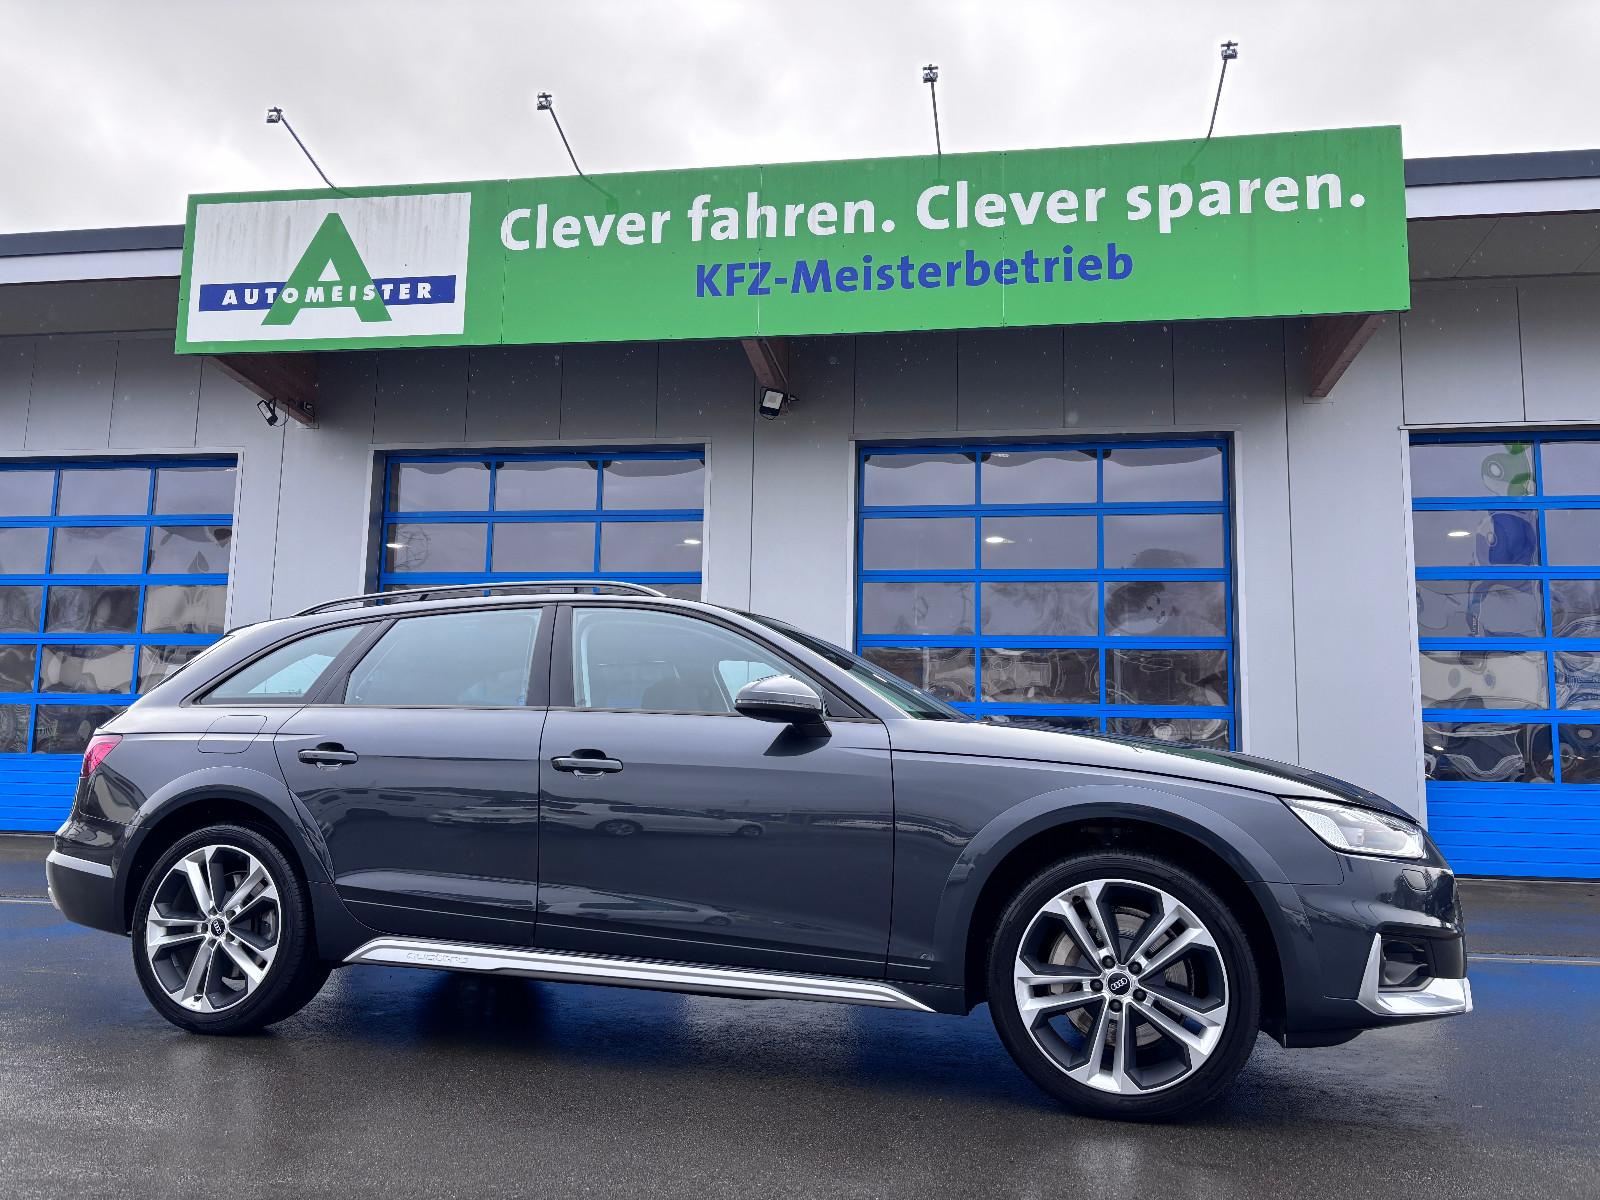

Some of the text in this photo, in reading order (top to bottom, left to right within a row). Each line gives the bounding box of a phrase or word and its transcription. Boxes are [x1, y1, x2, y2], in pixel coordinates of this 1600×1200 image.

[500, 172, 1366, 251] Clever fahren. Clever sparen.
[221, 282, 432, 306] AUTOMEISTER
[261, 211, 392, 326] A
[696, 243, 1133, 298] KFZ-Meisterbetrieb
